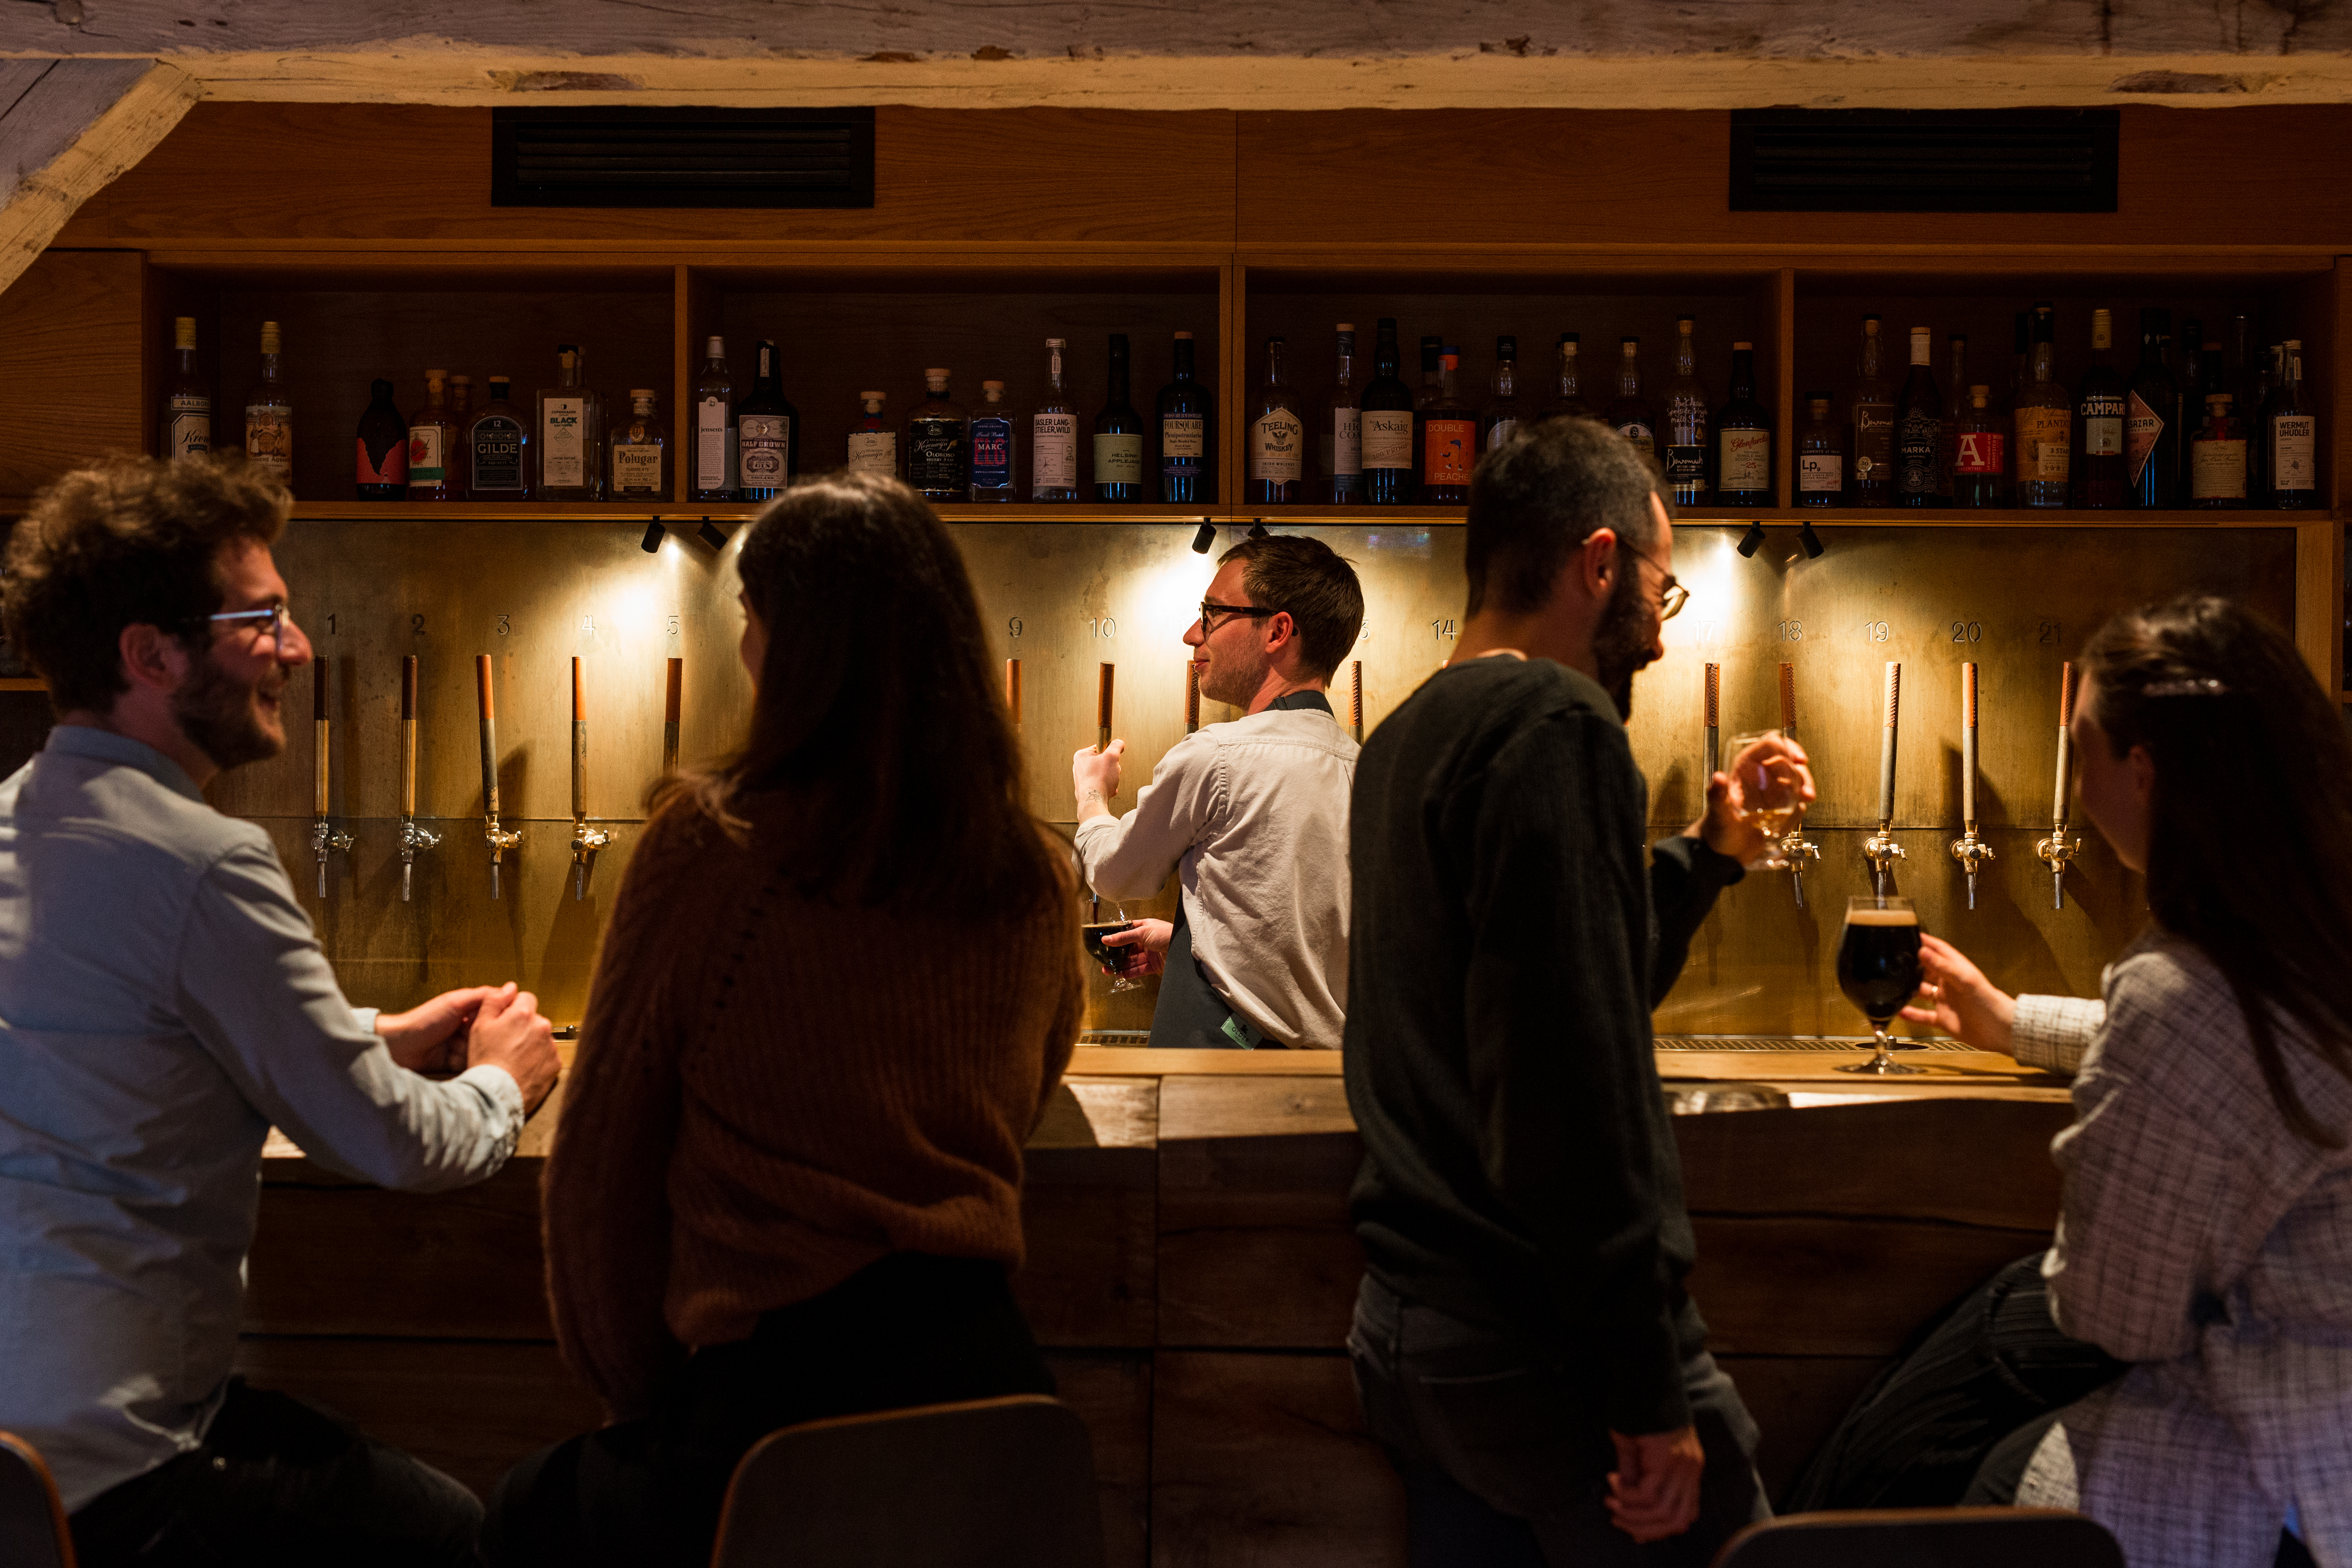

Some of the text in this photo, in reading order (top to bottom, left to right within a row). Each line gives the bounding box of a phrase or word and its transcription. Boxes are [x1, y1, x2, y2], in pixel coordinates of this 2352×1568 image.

[1674, 399, 1685, 407] The
[1165, 420, 1202, 431] FOURSQUARE
[1261, 421, 1298, 435] TEELING
[1373, 420, 1408, 435] Askaig
[477, 444, 517, 453] GILDE
[617, 451, 658, 466] Polugar
[975, 438, 1006, 465] ELG
[1386, 445, 1408, 455] PROOF
[1955, 434, 1985, 466] A
[1666, 448, 1703, 472] Benromach
[328, 613, 336, 635] 1
[411, 614, 425, 636] 2
[497, 614, 510, 636] 3
[581, 615, 595, 636] 4
[667, 615, 681, 636] 5
[1009, 617, 1022, 638] 9
[1089, 617, 1116, 638] 10
[1432, 619, 1457, 640] 14
[1692, 620, 1716, 641] 17
[1778, 620, 1802, 642] 18
[1865, 621, 1889, 642] 19
[1952, 621, 1982, 643] 20
[2038, 621, 2062, 643] 21
[1232, 1027, 1249, 1043] OLDER
